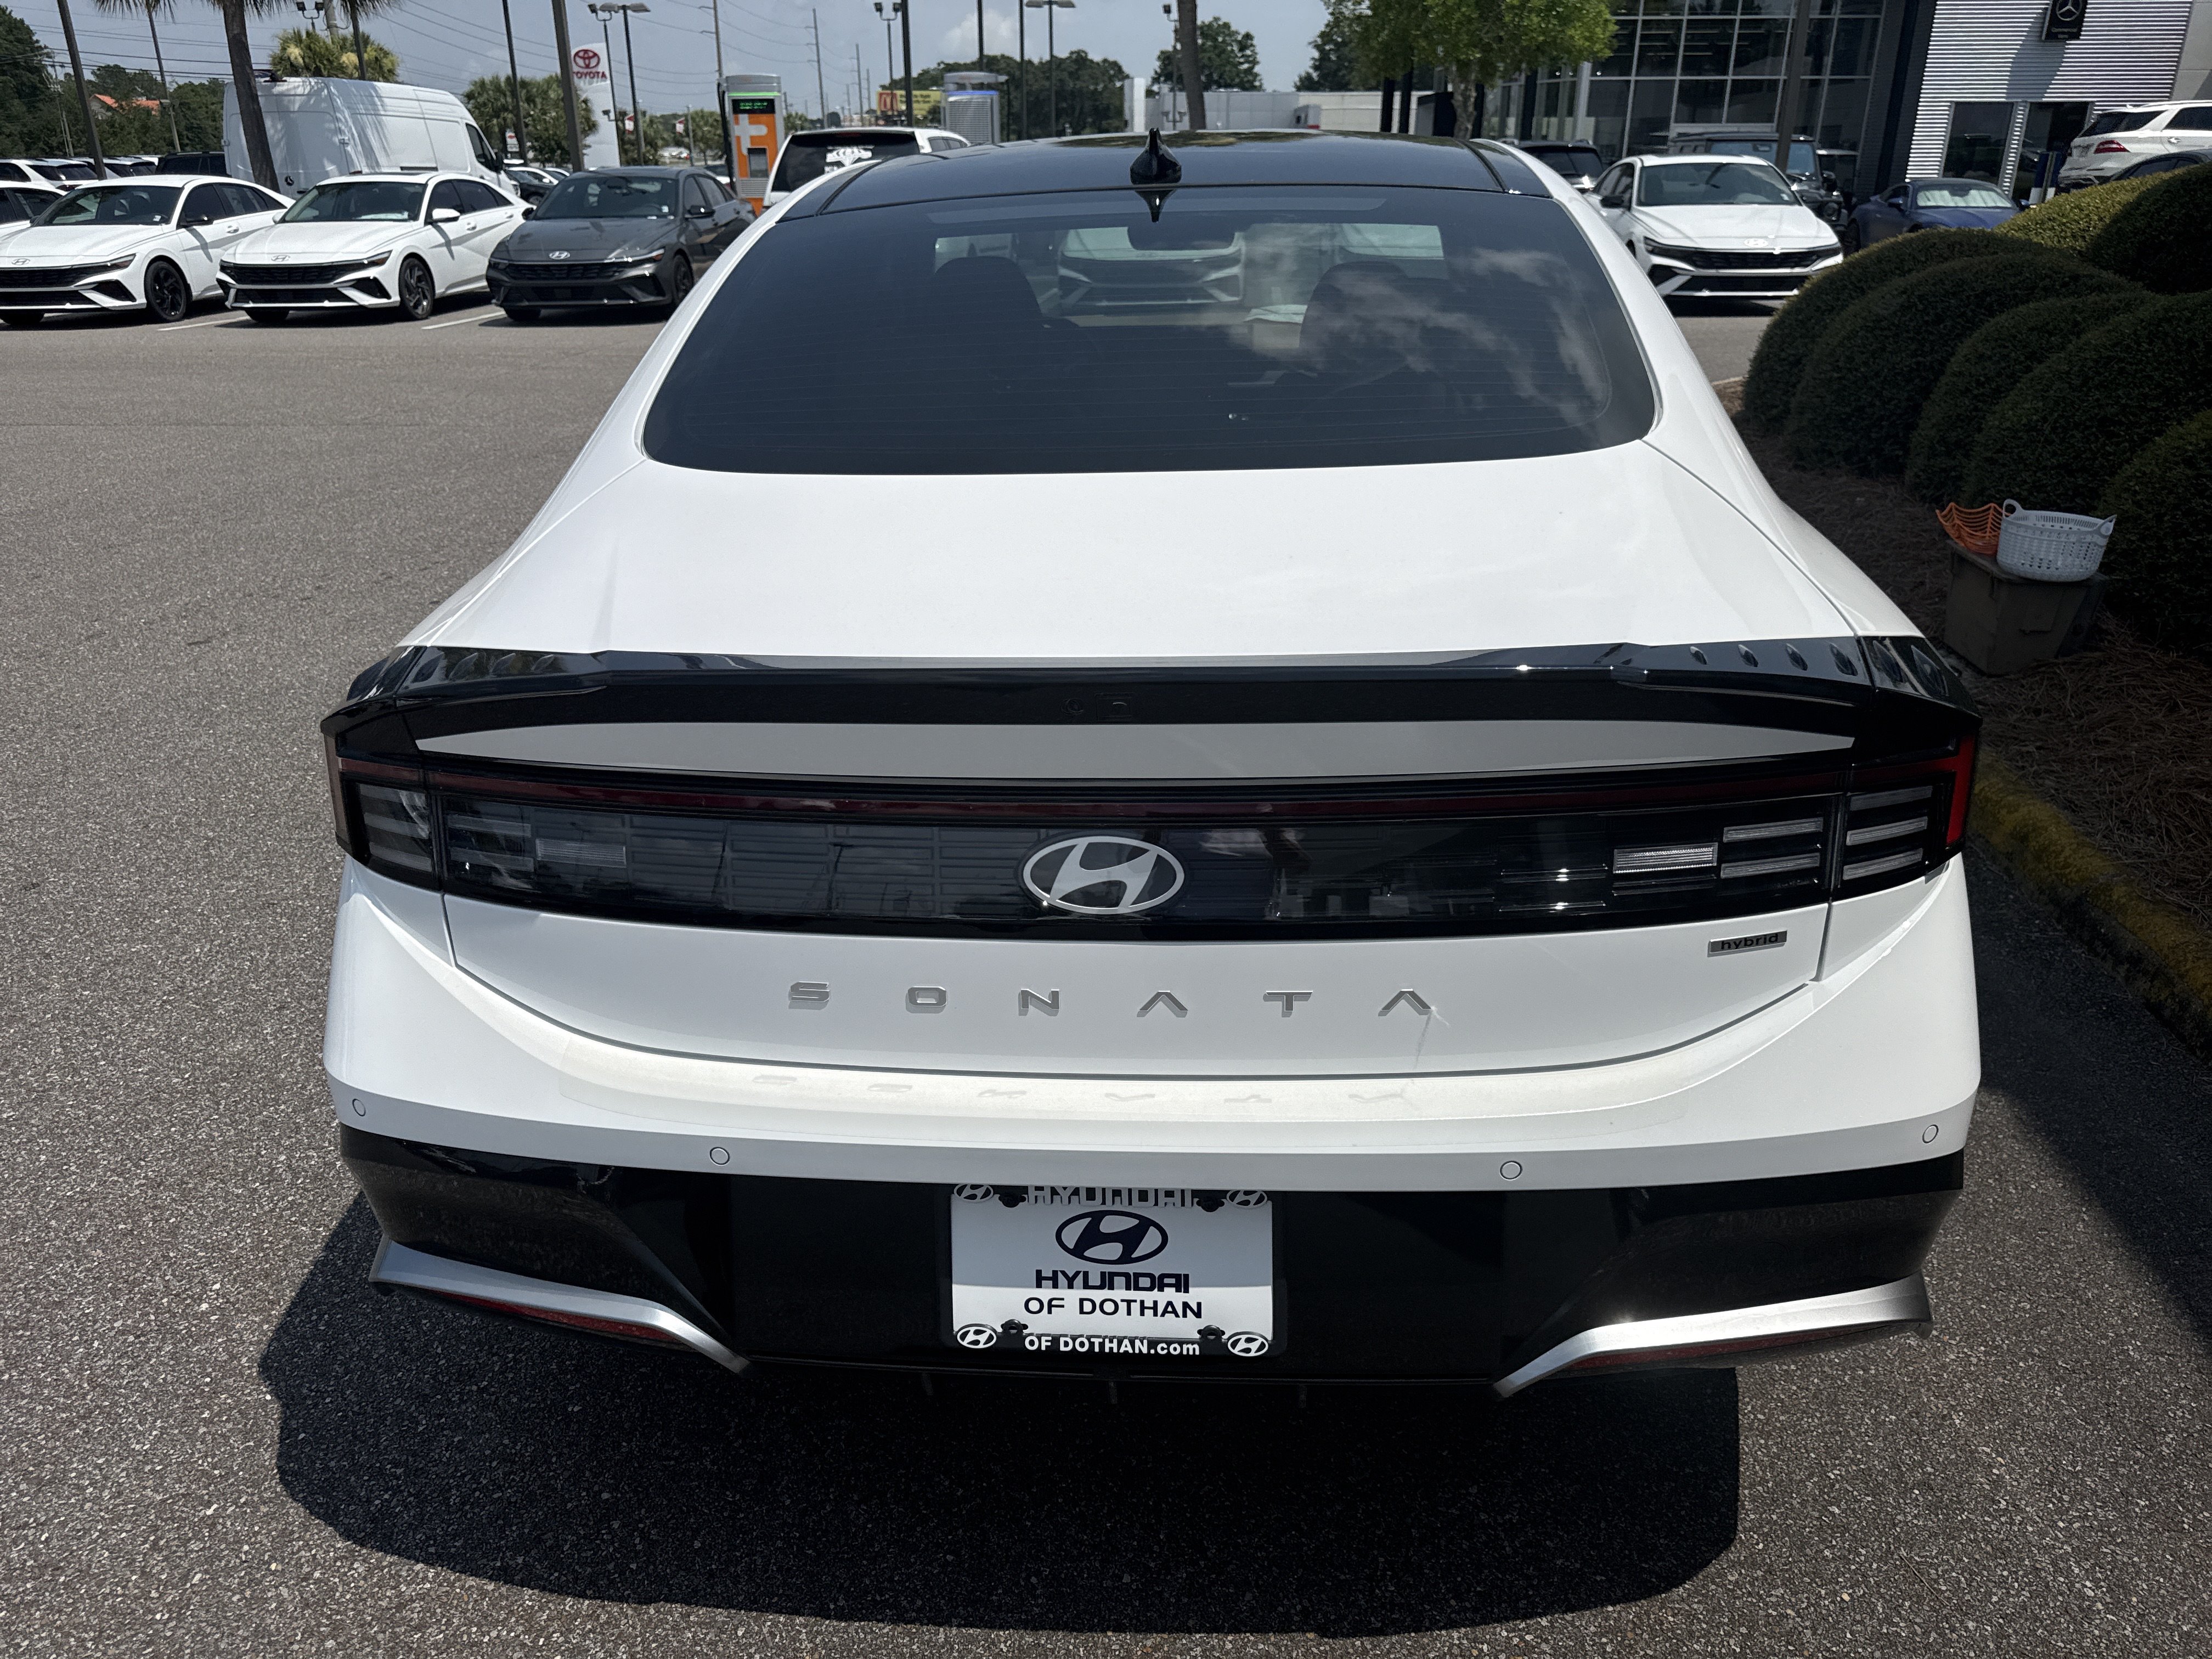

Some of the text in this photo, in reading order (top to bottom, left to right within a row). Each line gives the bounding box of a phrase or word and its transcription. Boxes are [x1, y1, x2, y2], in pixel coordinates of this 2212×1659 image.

[1720, 933, 1778, 950] hybrid
[790, 980, 1432, 1011] SONATA
[1028, 1186, 1192, 1207] HYUNDAI
[1035, 1269, 1189, 1294] HYUNDAI
[1024, 1297, 1202, 1319] OF DOTHAN
[1024, 1335, 1200, 1355] OF DOTHAN.com
